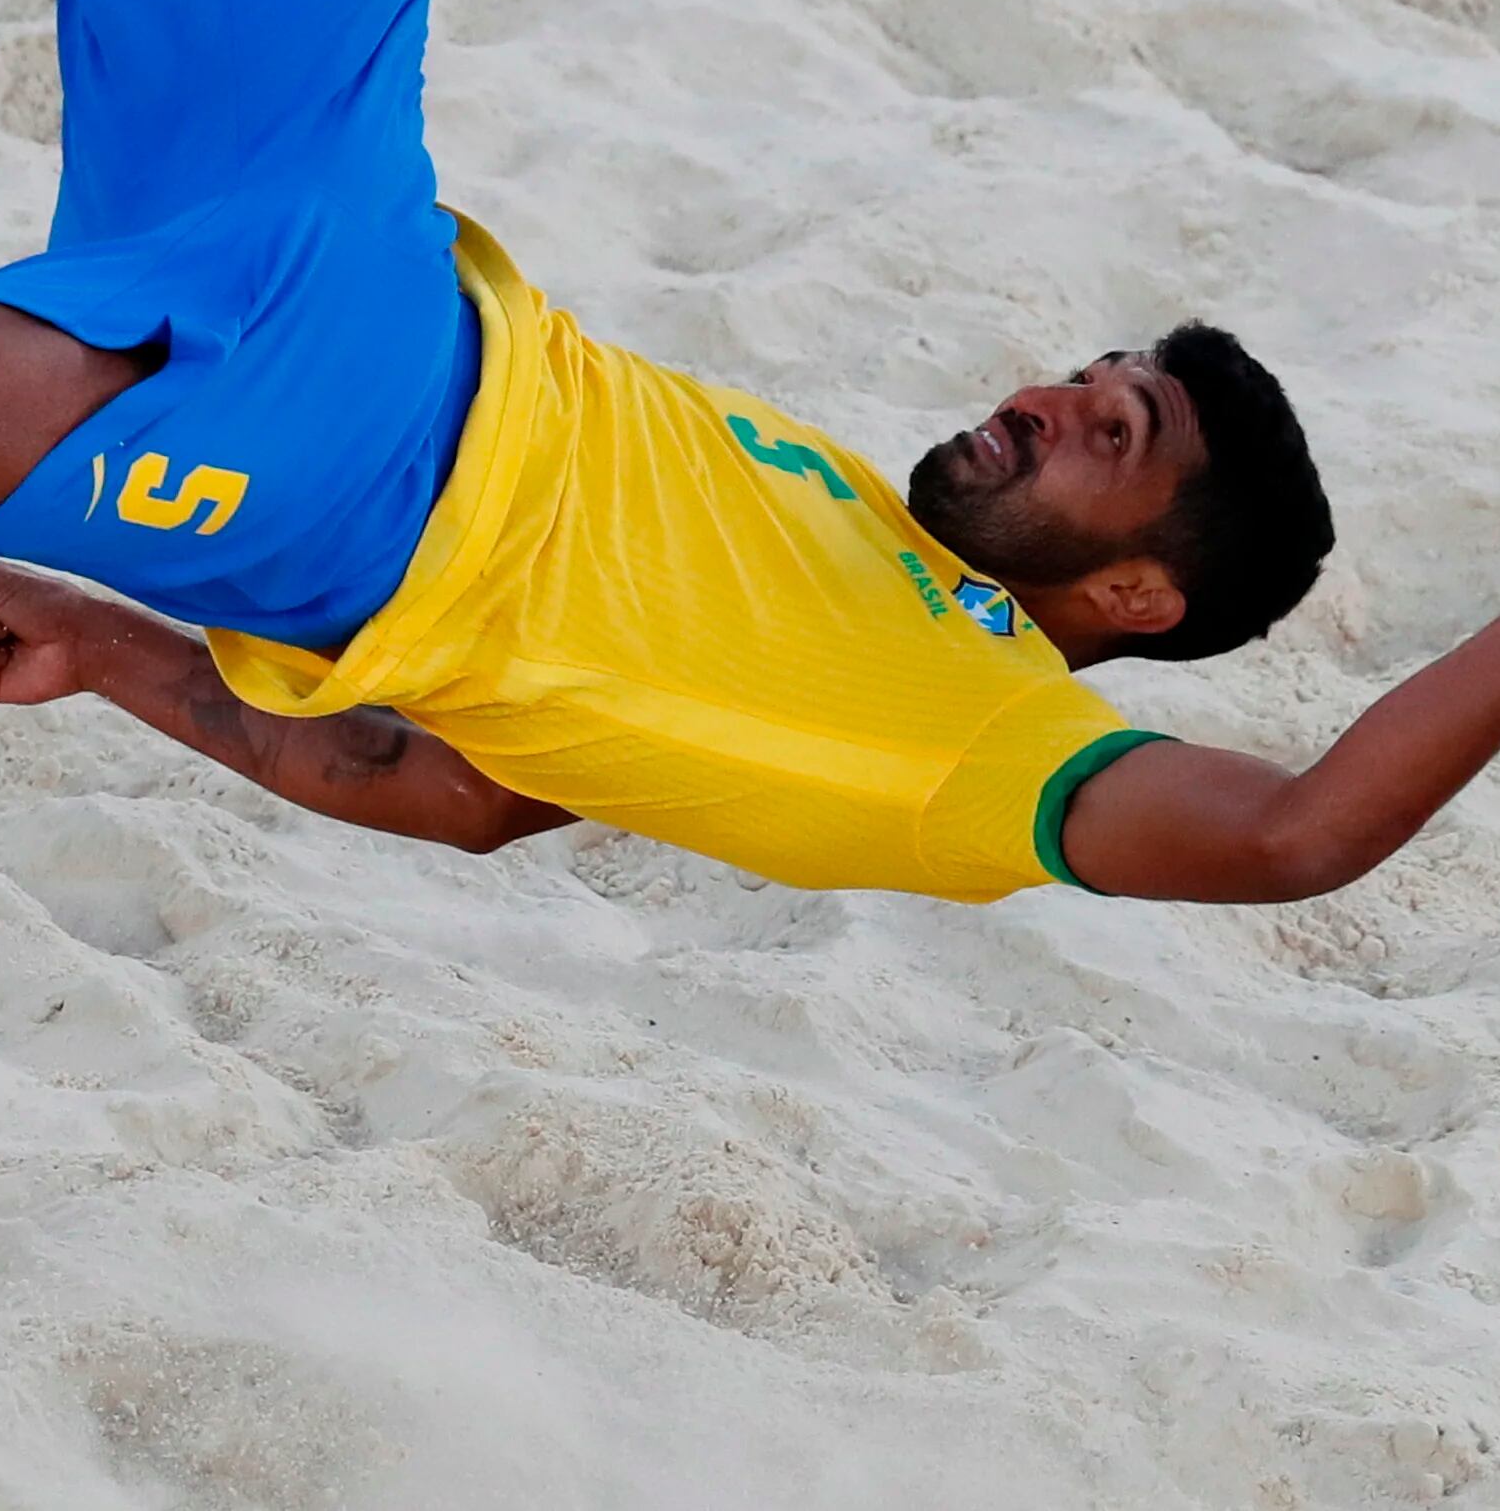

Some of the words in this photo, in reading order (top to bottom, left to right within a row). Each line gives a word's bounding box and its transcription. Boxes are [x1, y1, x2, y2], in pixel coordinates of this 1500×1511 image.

[116, 451, 250, 536] 5
[725, 412, 859, 502] 5
[898, 551, 949, 620] BRASIL
